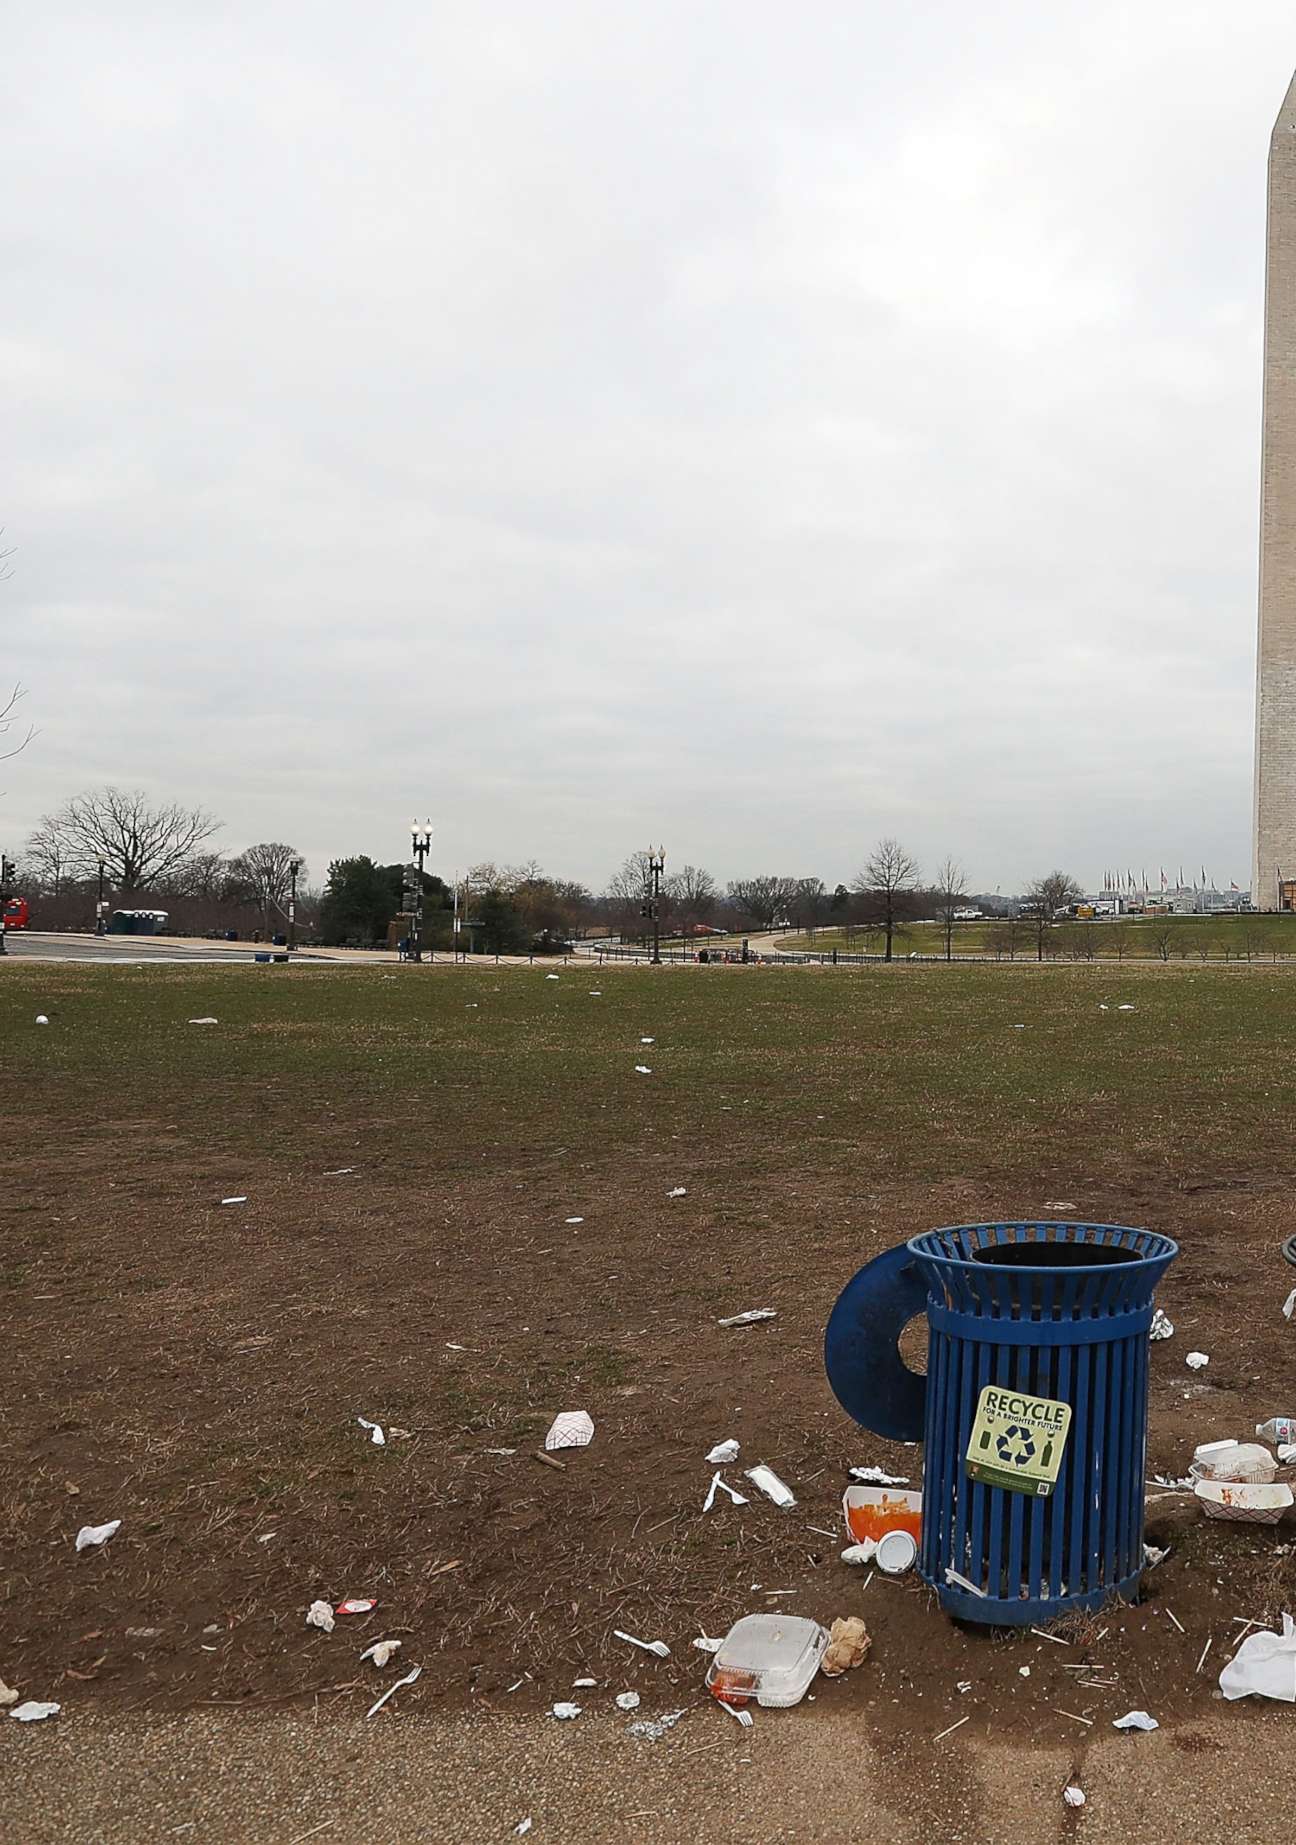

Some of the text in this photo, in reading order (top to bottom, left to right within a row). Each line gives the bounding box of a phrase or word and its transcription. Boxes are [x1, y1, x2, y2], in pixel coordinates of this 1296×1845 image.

[983, 1406, 995, 1415] FOR
[1003, 1413, 1035, 1426] BRIGHTER
[1037, 1421, 1063, 1431] FUTURE
[986, 1391, 1065, 1423] RECYCLE
